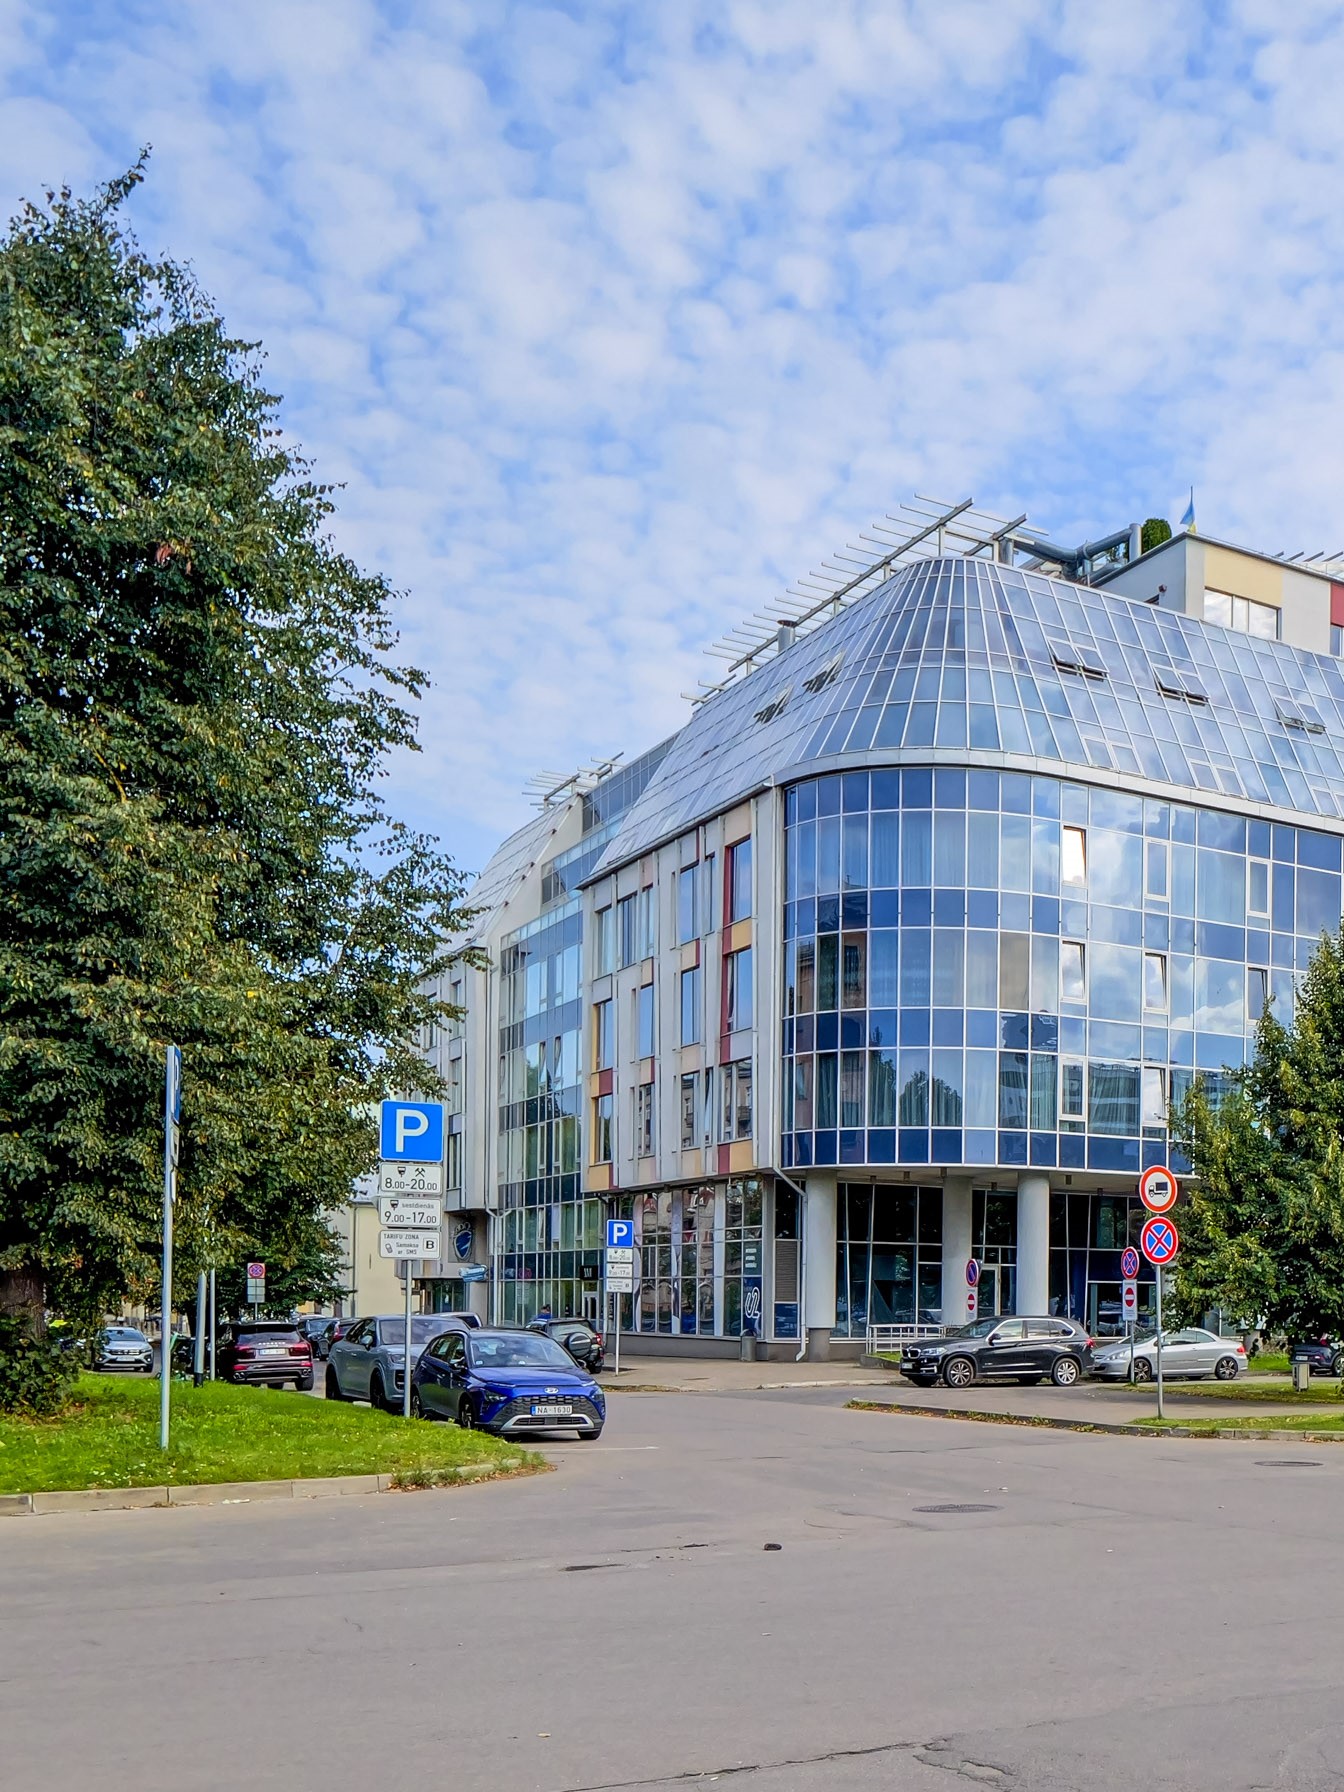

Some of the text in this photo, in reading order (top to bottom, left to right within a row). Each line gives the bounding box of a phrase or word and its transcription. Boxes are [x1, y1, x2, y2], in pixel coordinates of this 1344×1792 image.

[395, 1109, 429, 1153] P
[385, 1177, 437, 1190] 8.00-20.00
[613, 1223, 628, 1244] P
[426, 1240, 434, 1249] B
